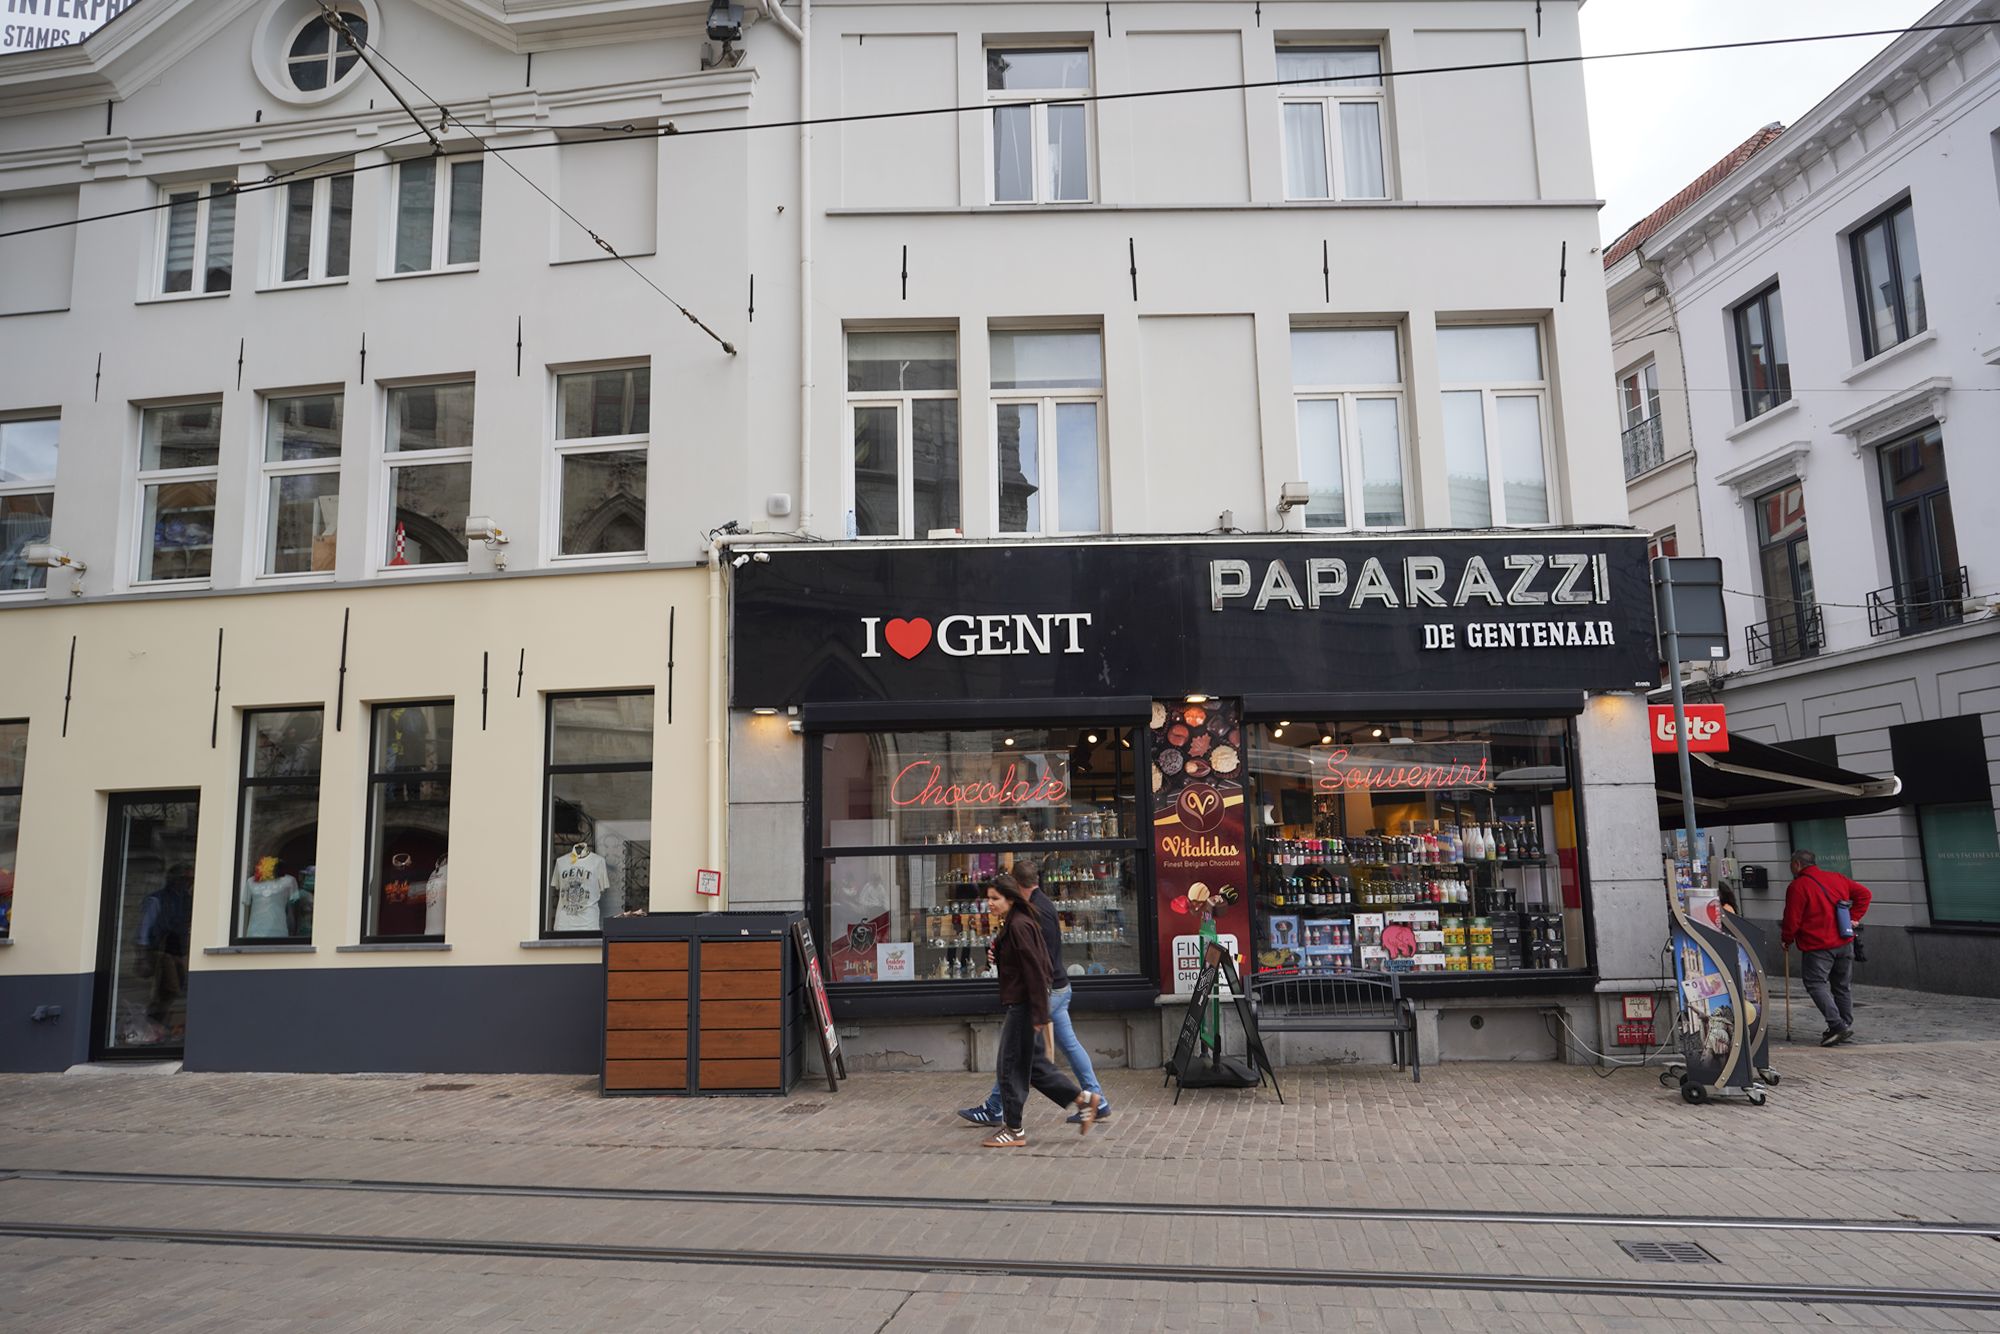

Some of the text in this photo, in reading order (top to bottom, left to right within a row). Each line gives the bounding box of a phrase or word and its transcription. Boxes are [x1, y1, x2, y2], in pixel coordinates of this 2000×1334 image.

[3, 25, 70, 49] STAMPS
[1211, 553, 1611, 611] PAPARAZZI
[861, 613, 1092, 657] I GENT
[1424, 621, 1615, 648] DE GENTENAAR
[1319, 749, 1488, 789] Souvenirs
[890, 760, 1068, 806] Chocolate
[1162, 836, 1239, 857] Vitalidas
[562, 868, 592, 879] GENT
[1184, 860, 1208, 869] Belgian
[1209, 859, 1240, 867] Chocolate
[1177, 941, 1233, 956] FINT
